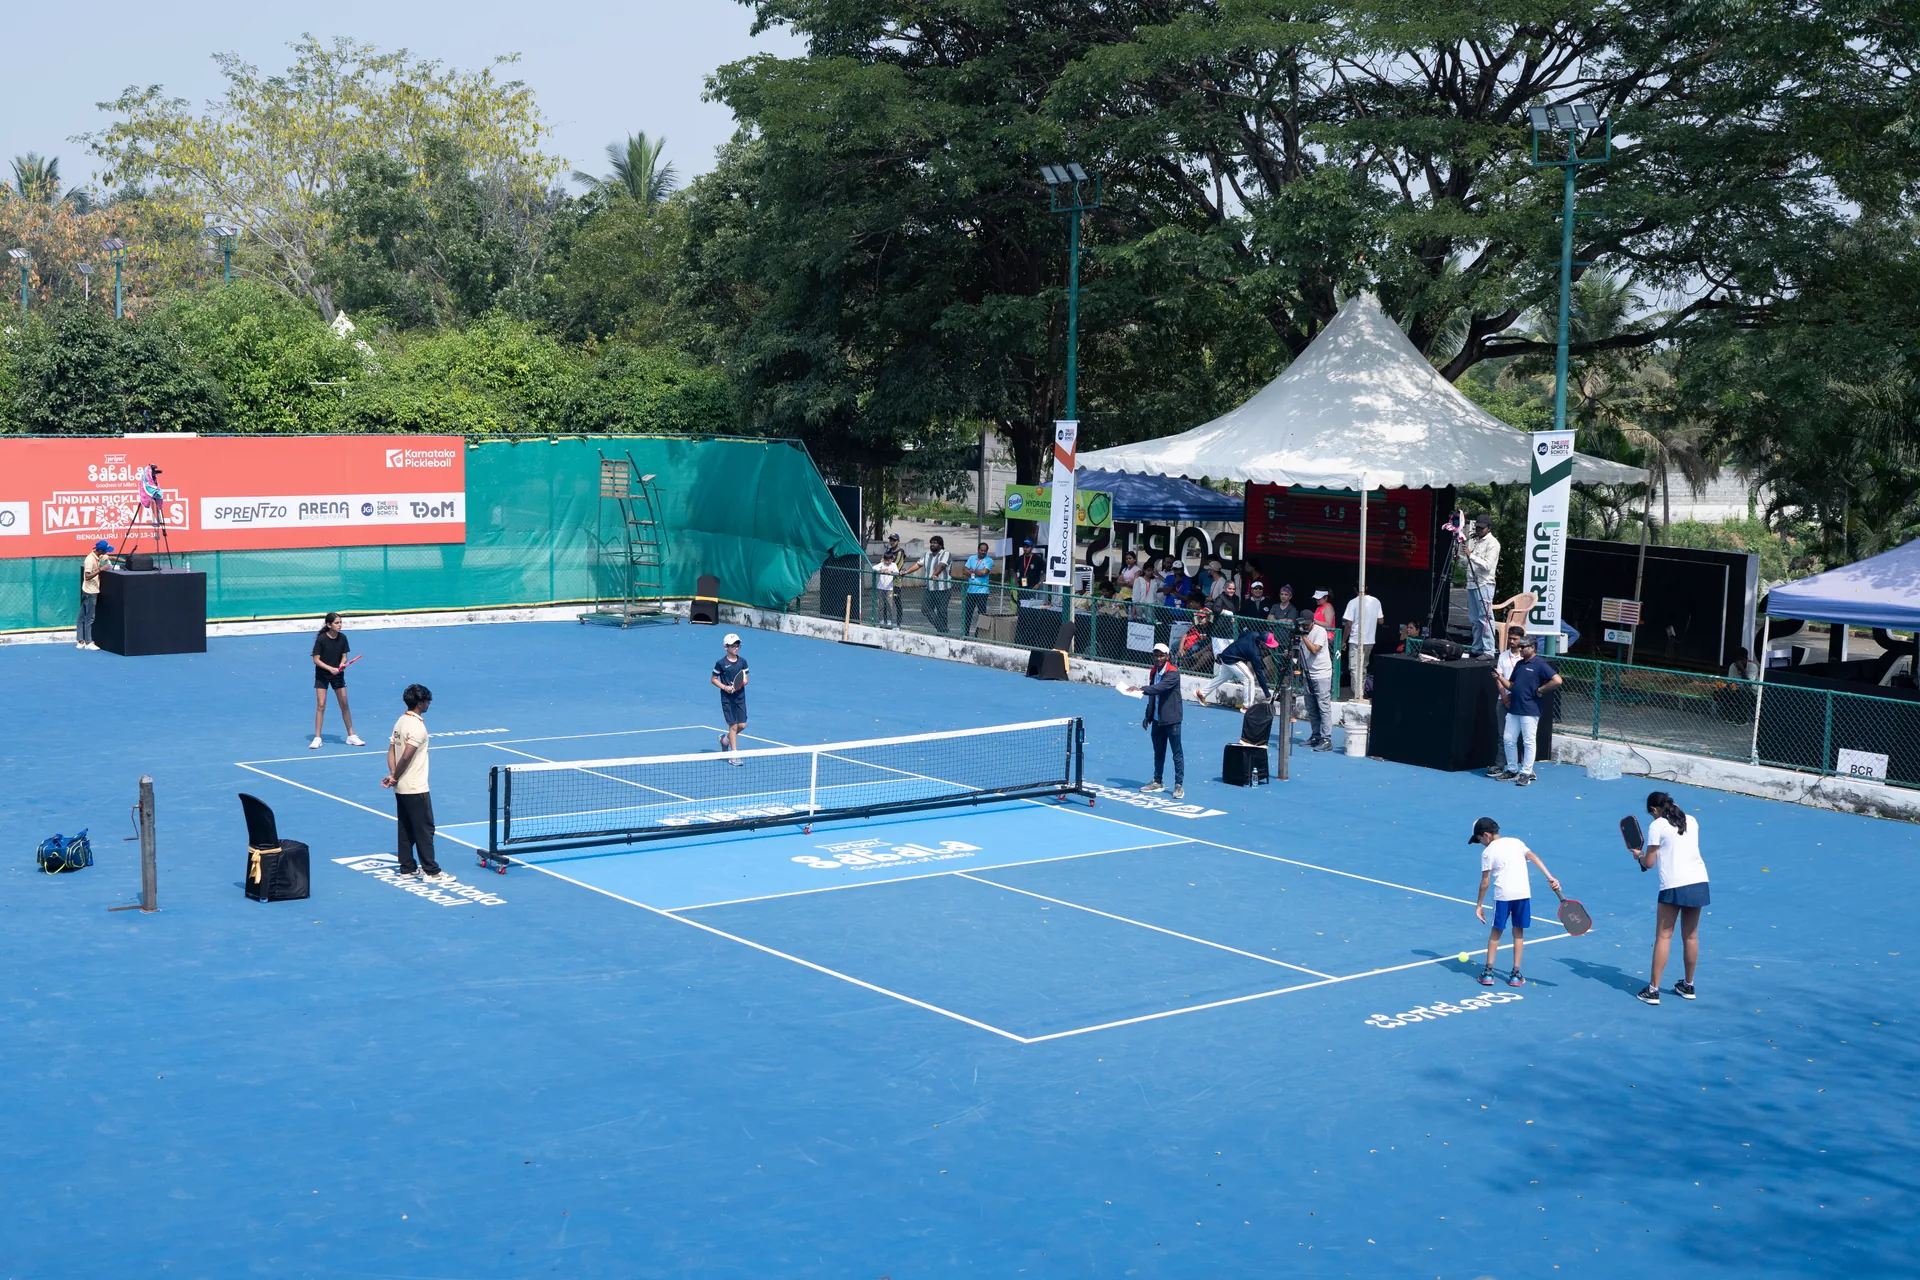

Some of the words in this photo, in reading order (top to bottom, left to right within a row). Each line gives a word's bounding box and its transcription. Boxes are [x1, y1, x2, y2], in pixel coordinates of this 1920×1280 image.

[404, 448, 456, 458] Karnataka
[404, 458, 452, 468] Pickleball
[88, 464, 144, 482] Sabala
[58, 495, 100, 505] INDIAN
[1025, 499, 1052, 509] HYDRATIO
[214, 502, 287, 522] SPRENTZO
[1061, 494, 1070, 565] RACQUETLY
[76, 533, 119, 541] BENGALURU
[1547, 569, 1557, 618] SPORTS
[1850, 764, 1873, 777] BCR
